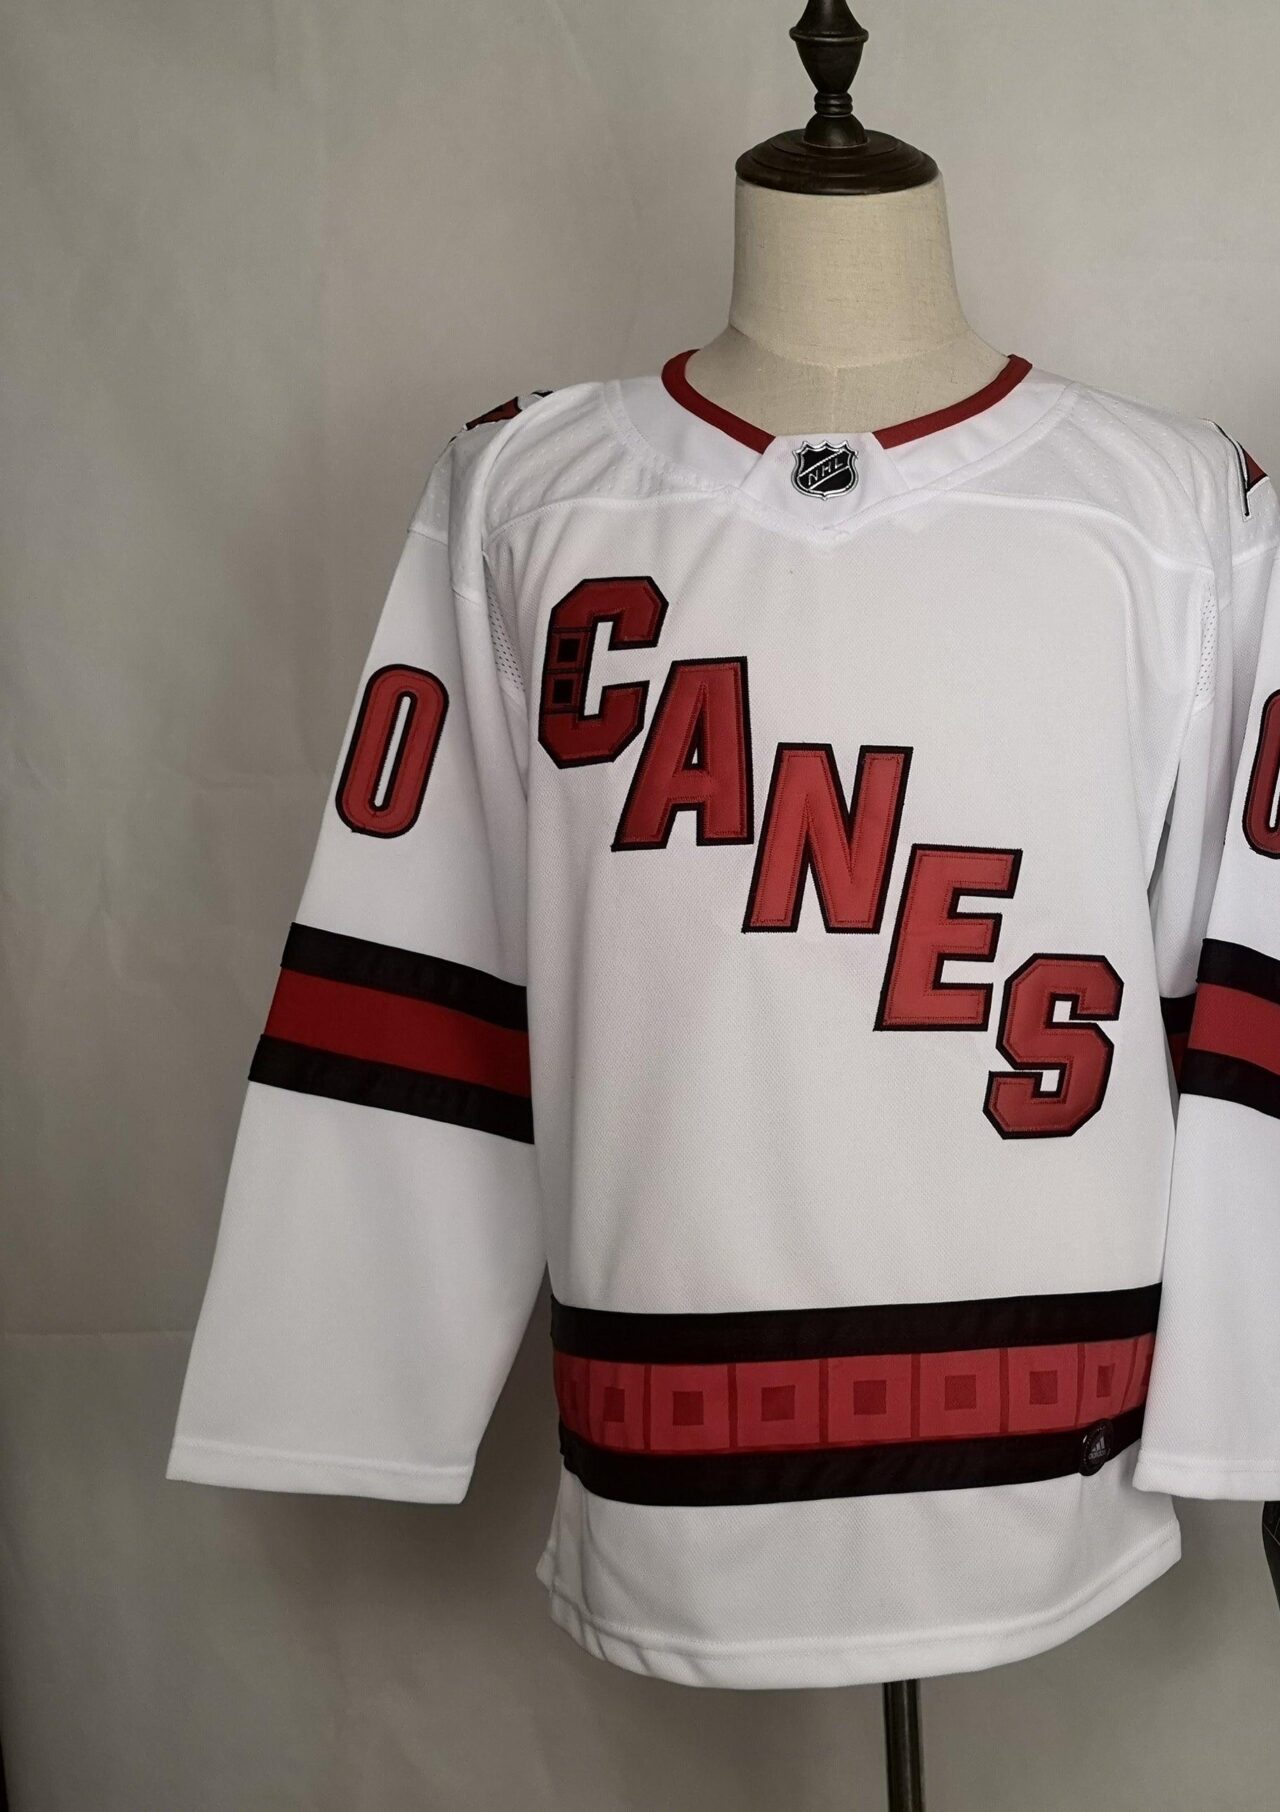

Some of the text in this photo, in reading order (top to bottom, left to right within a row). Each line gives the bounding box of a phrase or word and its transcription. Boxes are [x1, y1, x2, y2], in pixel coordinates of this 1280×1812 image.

[807, 457, 844, 486] NHL
[334, 663, 450, 840] 0
[537, 575, 1125, 1141] CANES
